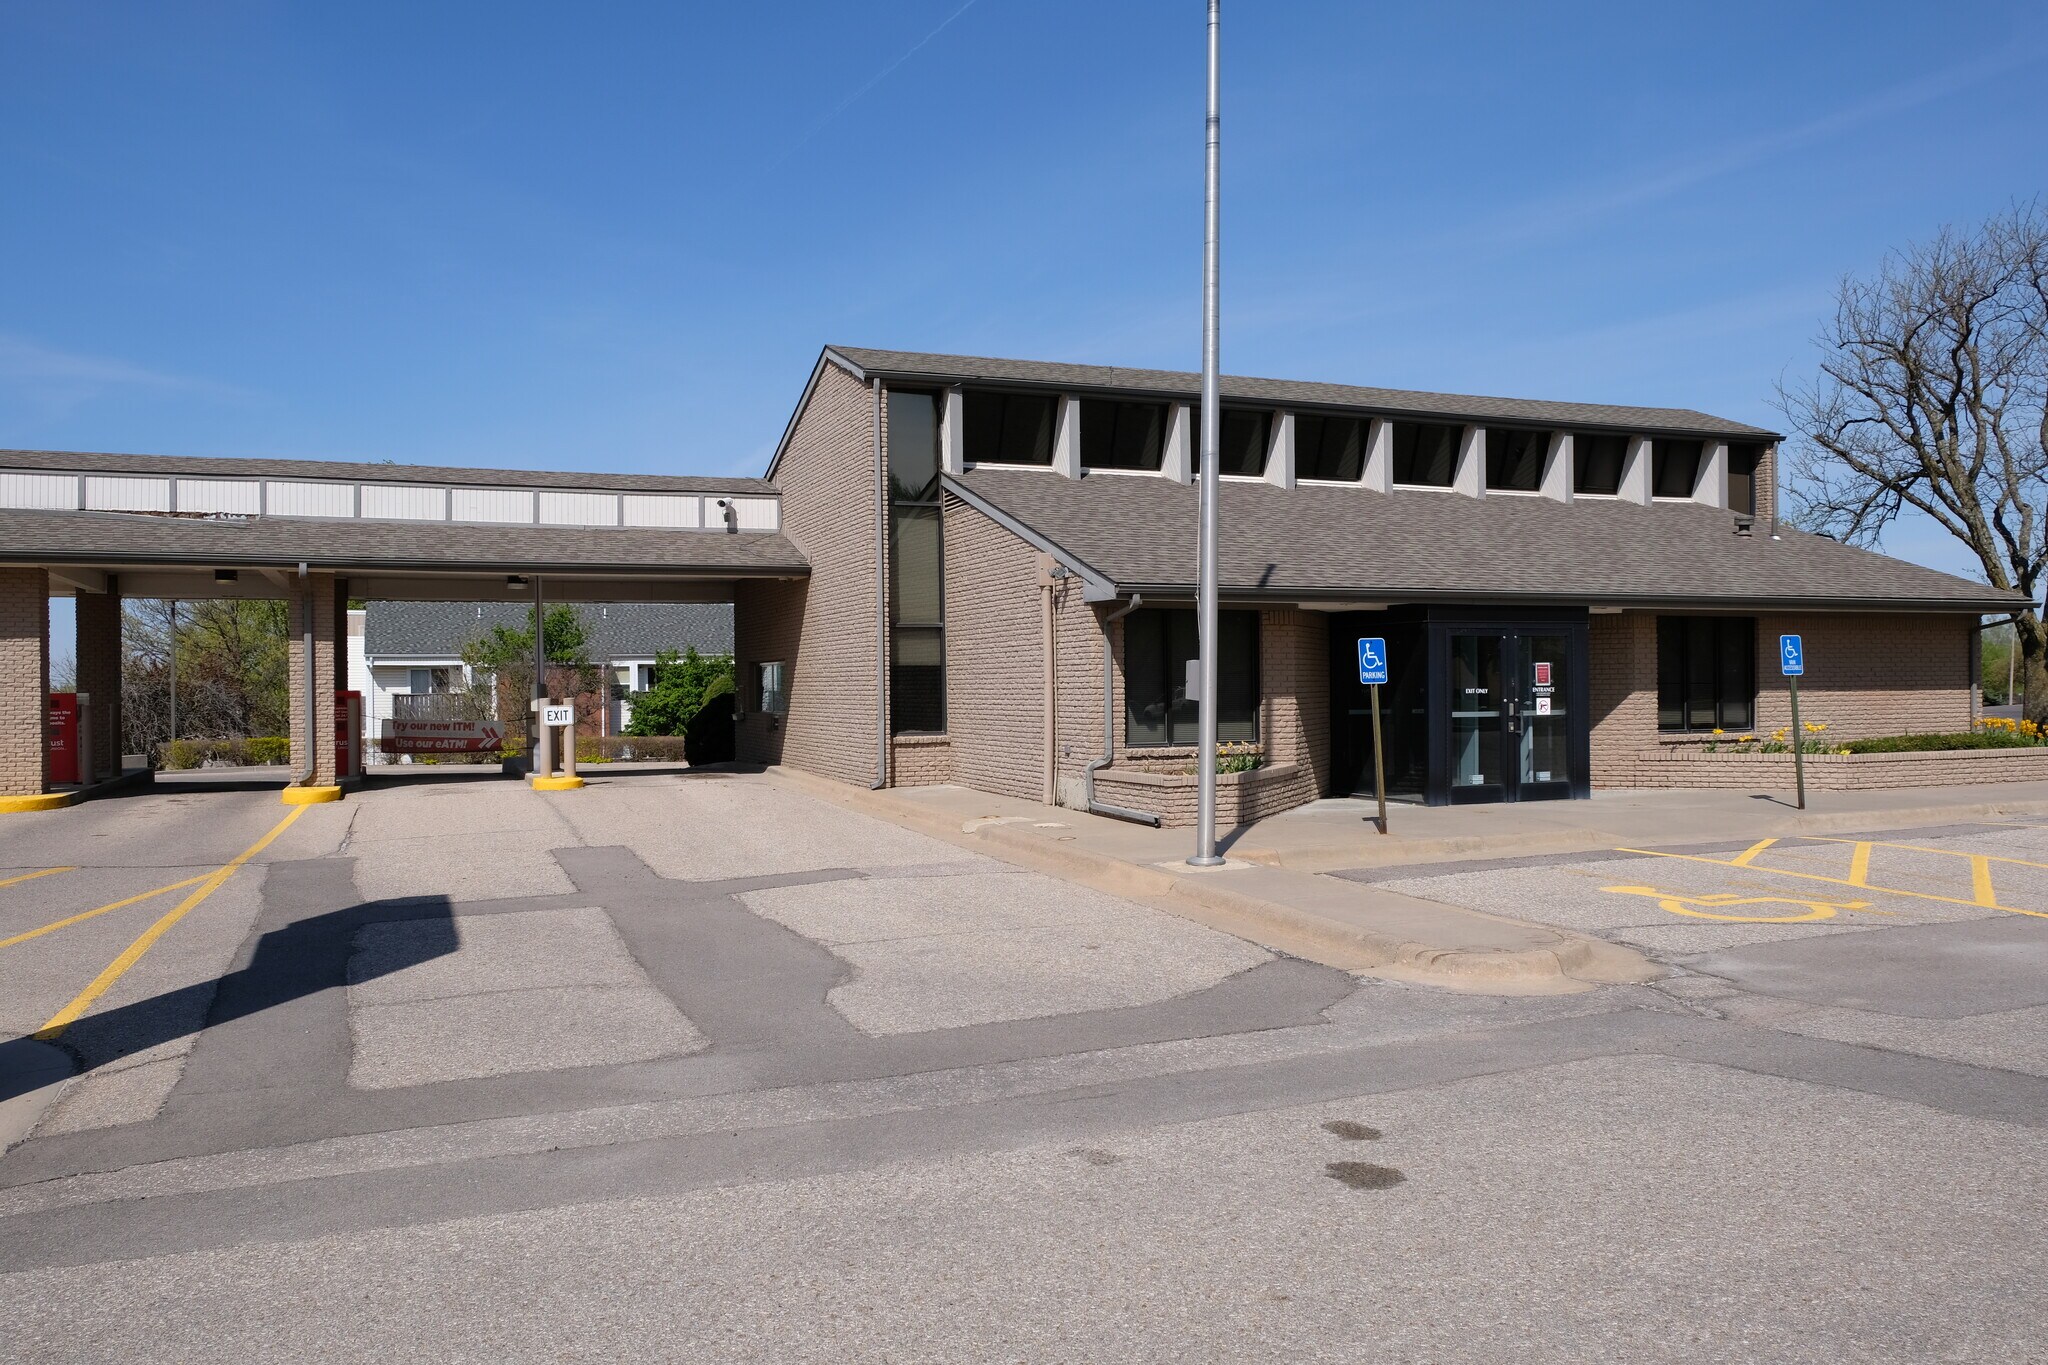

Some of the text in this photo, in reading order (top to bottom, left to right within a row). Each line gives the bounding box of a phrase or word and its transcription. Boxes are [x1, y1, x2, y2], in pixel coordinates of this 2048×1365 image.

[1362, 671, 1386, 680] PARKING
[547, 710, 569, 722] EXIT
[392, 720, 475, 732] Try our new ITM!
[395, 738, 468, 749] Use our eATM!
